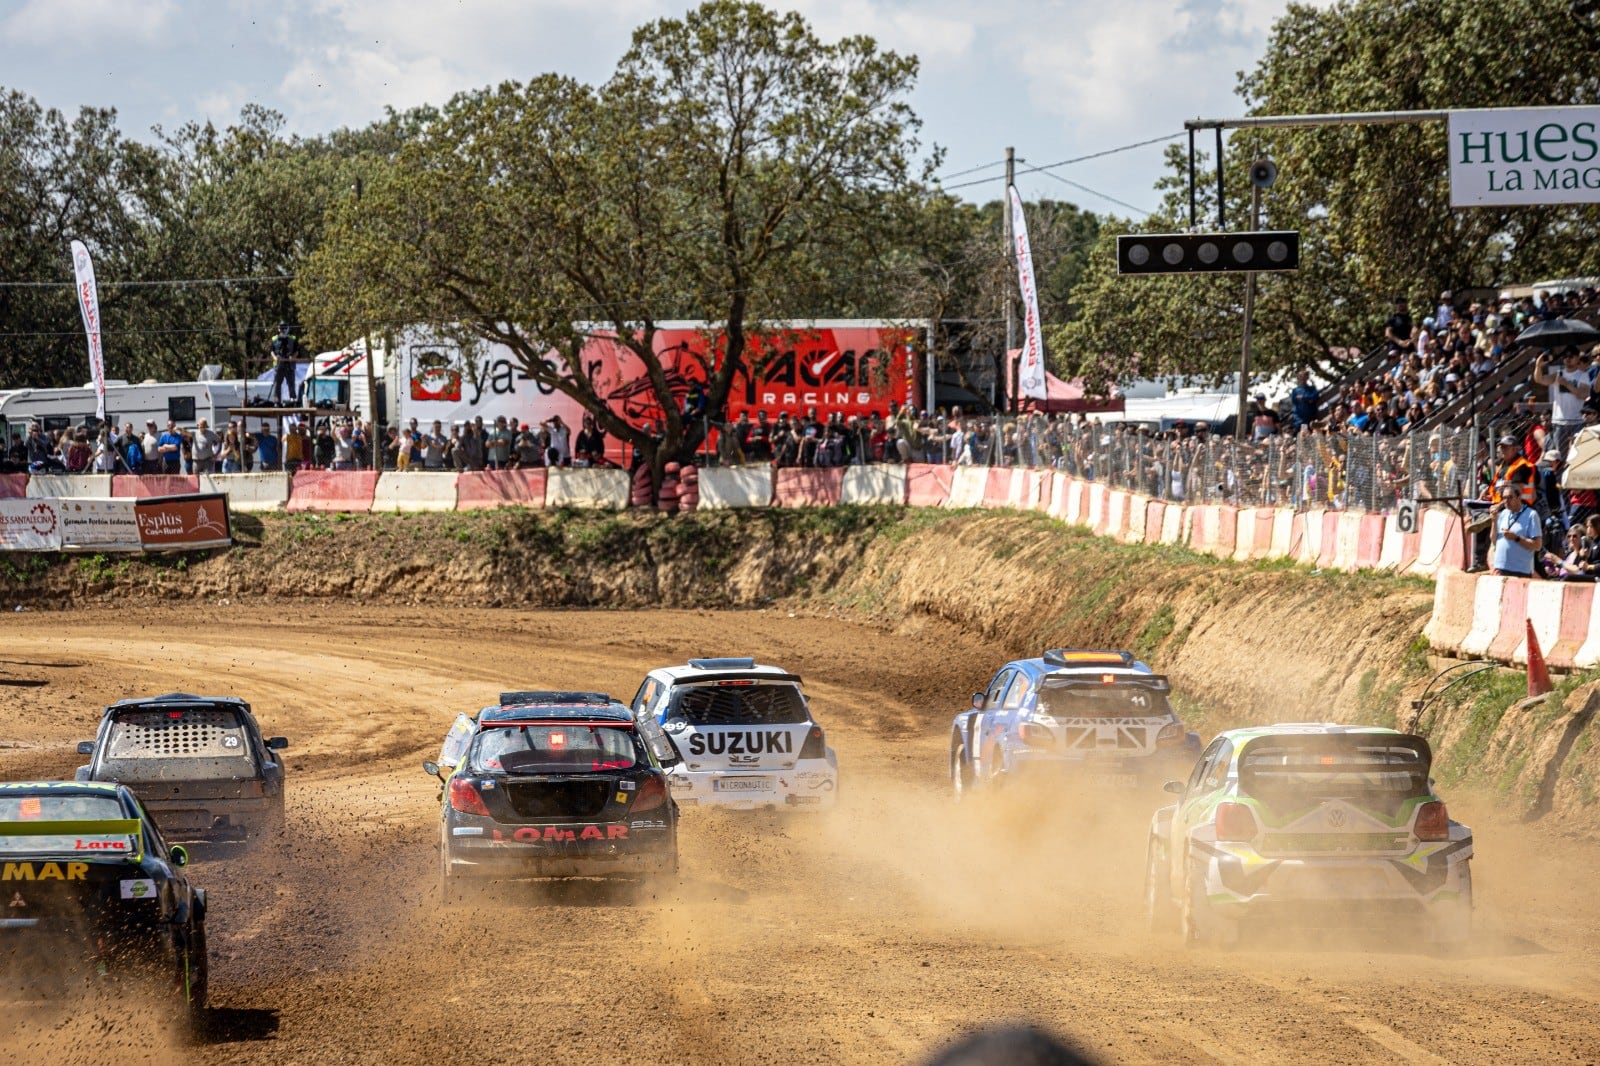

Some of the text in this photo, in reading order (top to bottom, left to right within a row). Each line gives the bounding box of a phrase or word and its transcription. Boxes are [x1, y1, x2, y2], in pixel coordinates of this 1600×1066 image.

[763, 392, 871, 405] RACING
[138, 512, 182, 529] Esplús
[1399, 505, 1412, 532] 6
[163, 526, 184, 535] Rural
[1131, 696, 1145, 706] 11
[225, 736, 238, 747] 29
[689, 731, 793, 755] SUZUKI
[492, 825, 629, 843] LOMAR
[74, 839, 126, 850] Lara
